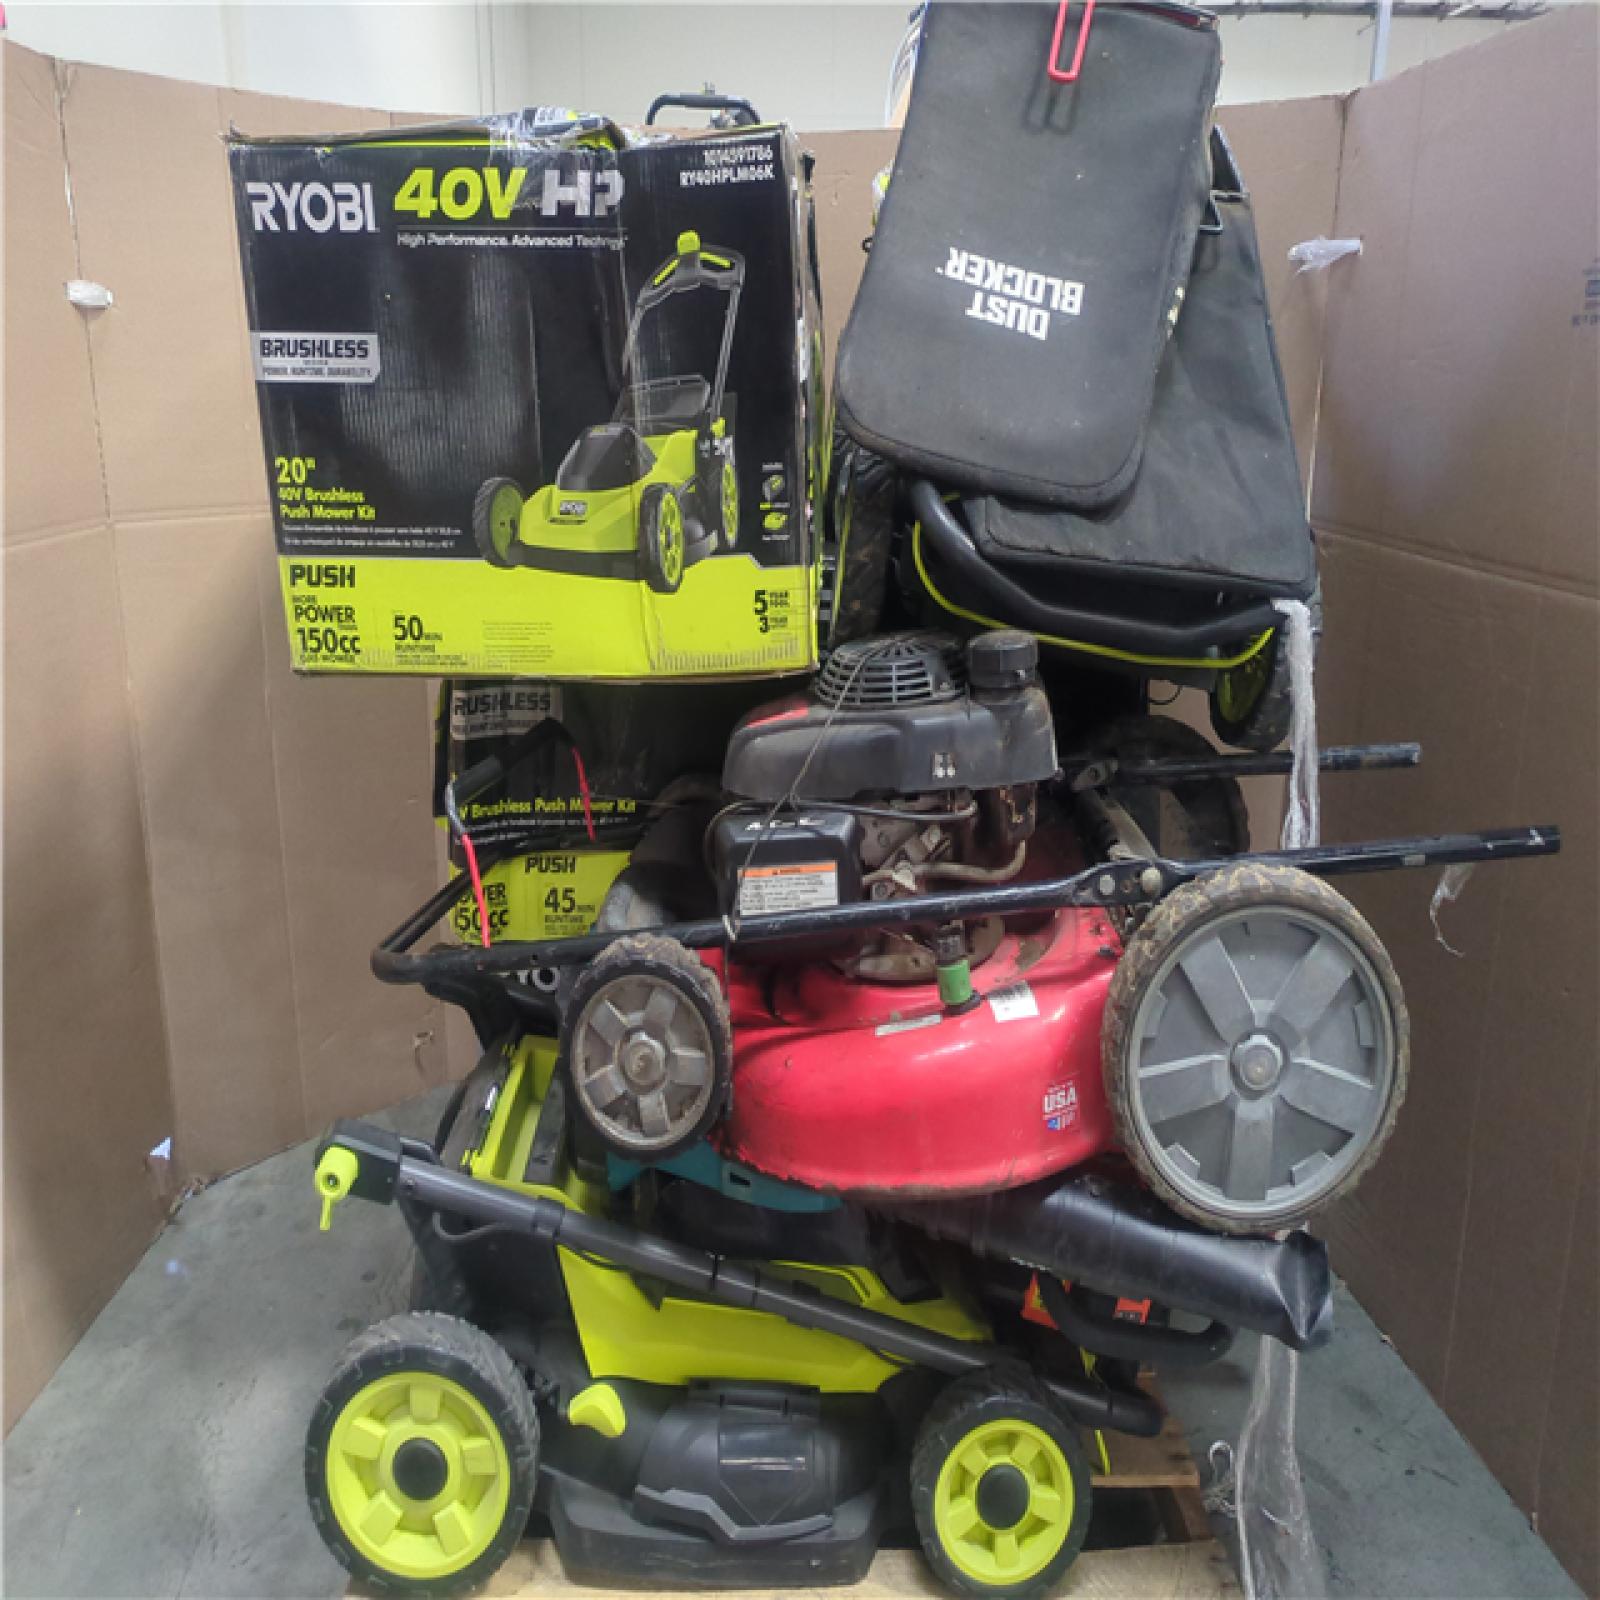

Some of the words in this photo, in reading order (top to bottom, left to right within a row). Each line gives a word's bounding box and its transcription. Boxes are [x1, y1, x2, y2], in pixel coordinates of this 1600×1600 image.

[393, 167, 529, 219] 40V
[540, 169, 625, 216] HP
[246, 182, 378, 232] RYOBI
[396, 232, 426, 248] High
[512, 234, 574, 247] Advanced
[944, 246, 1086, 316] BLOCKER
[965, 290, 1050, 340] DUST
[259, 339, 369, 358] BRUSHLESS
[274, 456, 316, 484] 20"
[278, 487, 302, 501] 40V
[304, 487, 366, 503] Brushless
[279, 505, 311, 519] Push
[311, 504, 356, 520] Mower
[357, 505, 377, 520] Kit
[290, 564, 356, 588] PUSH
[294, 604, 355, 623] POWER
[754, 589, 768, 615] 5
[394, 615, 423, 640] 50
[759, 615, 768, 633] 3
[297, 627, 361, 654] 150cc
[454, 689, 551, 716] RUSHLESS
[471, 797, 531, 819] Brushless
[534, 797, 566, 813] Push
[569, 797, 614, 813] Mwer
[617, 798, 636, 813] Kit
[524, 856, 576, 874] PUSH
[544, 887, 576, 913] 45
[455, 906, 510, 931] 50cc
[1043, 1087, 1076, 1113] USA
